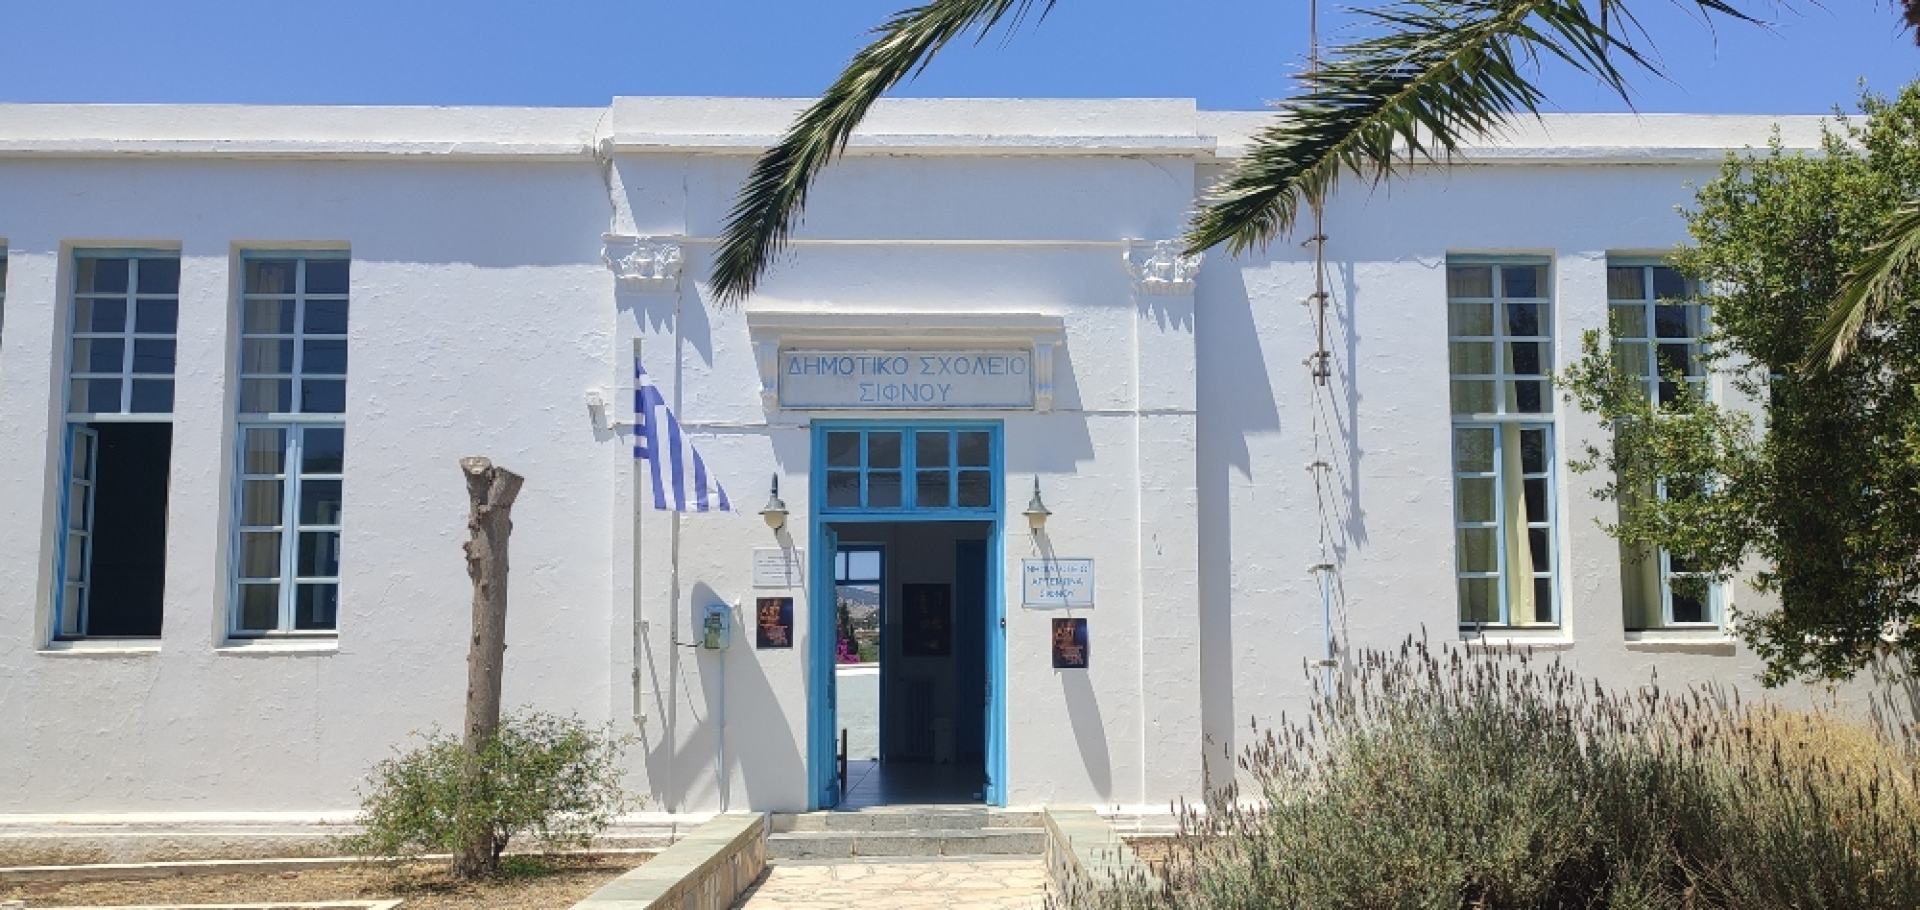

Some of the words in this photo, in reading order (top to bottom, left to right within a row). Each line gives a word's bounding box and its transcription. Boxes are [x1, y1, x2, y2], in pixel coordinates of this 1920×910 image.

[787, 356, 909, 376] ΔΗΜΟΤΙΚΟ
[919, 356, 1027, 376] ΣΧΟΛΕΙΟ
[859, 383, 952, 402] ΣΙΦΝΟΥ
